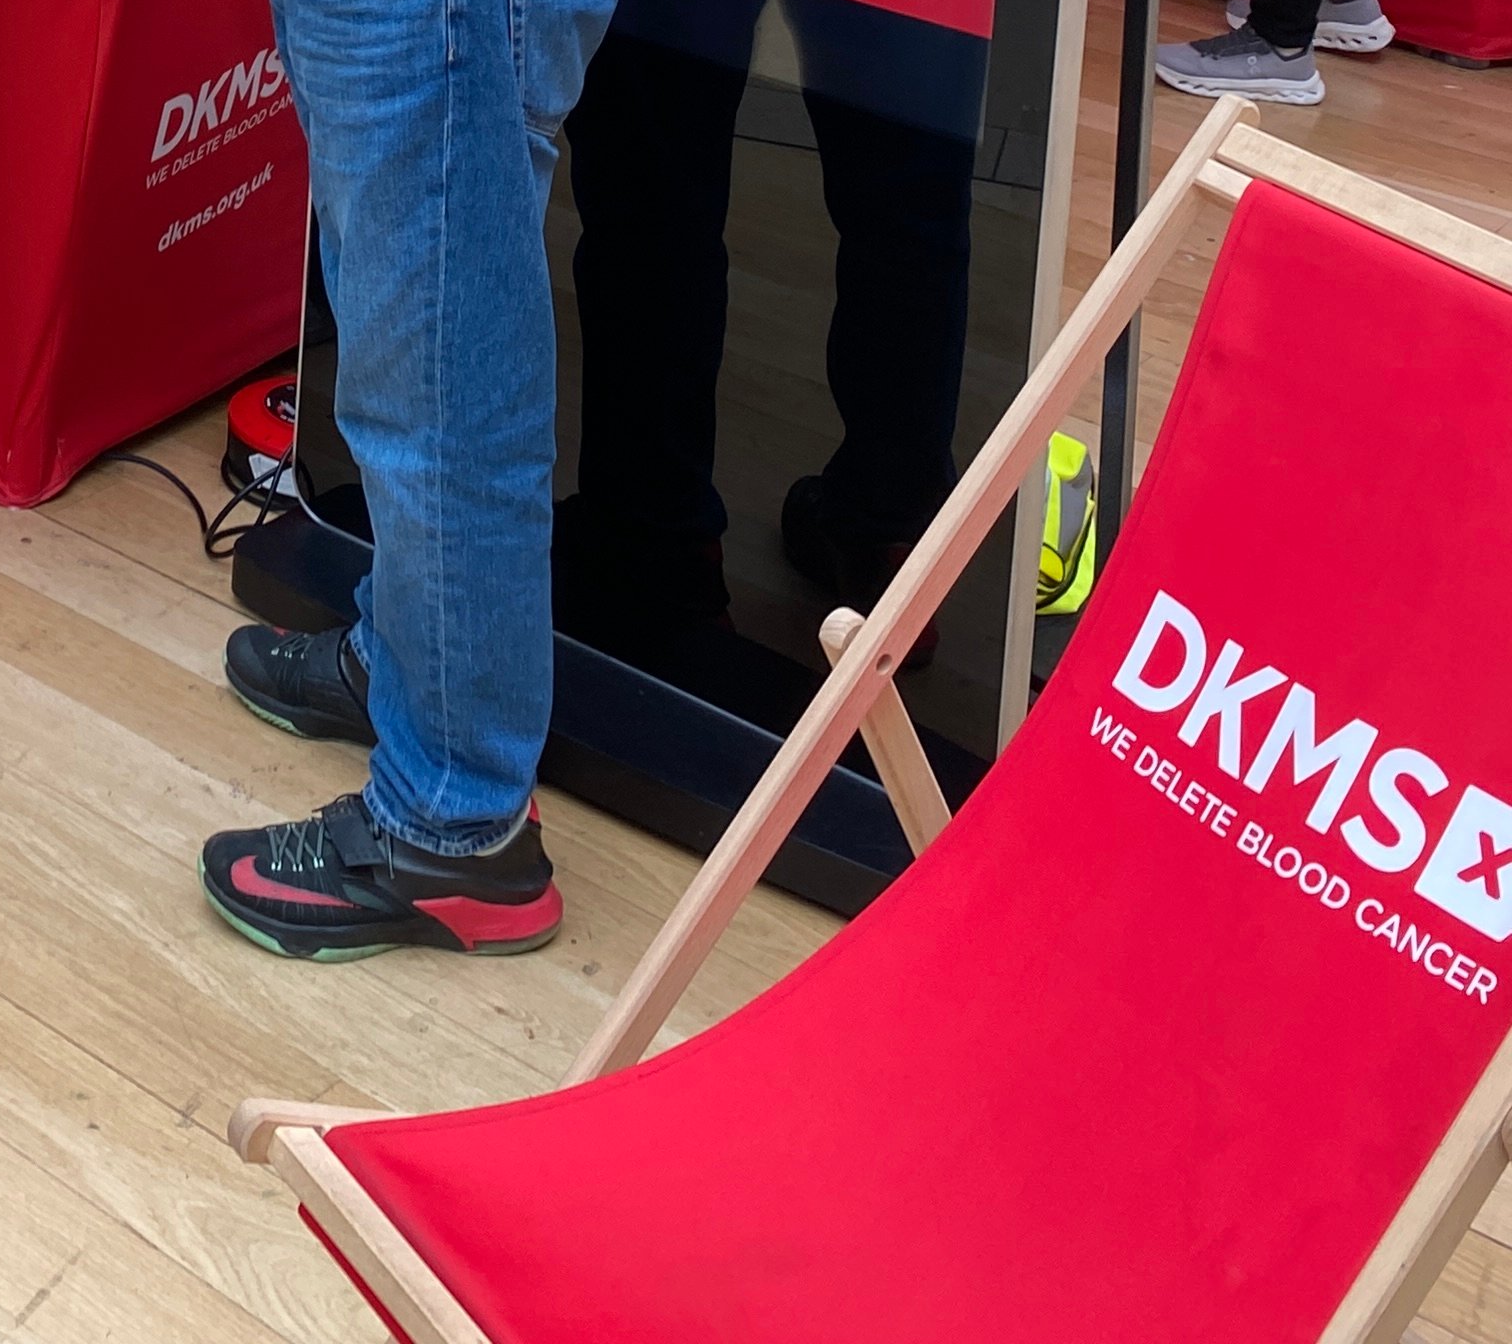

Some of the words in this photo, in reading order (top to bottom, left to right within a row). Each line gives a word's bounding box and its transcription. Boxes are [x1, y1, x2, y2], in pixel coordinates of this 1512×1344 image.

[146, 165, 169, 190] WE
[171, 135, 222, 177] DELETE
[223, 109, 268, 145] BLOOD
[269, 93, 294, 117] CAN
[151, 47, 288, 163] DKMS
[157, 161, 275, 252] dkms.org.uk
[1112, 589, 1450, 873] DKMS
[1090, 706, 1138, 762] WE
[1133, 744, 1239, 838] DELETE
[1236, 821, 1351, 911] BLOOD
[1354, 898, 1499, 1006] CANCER
